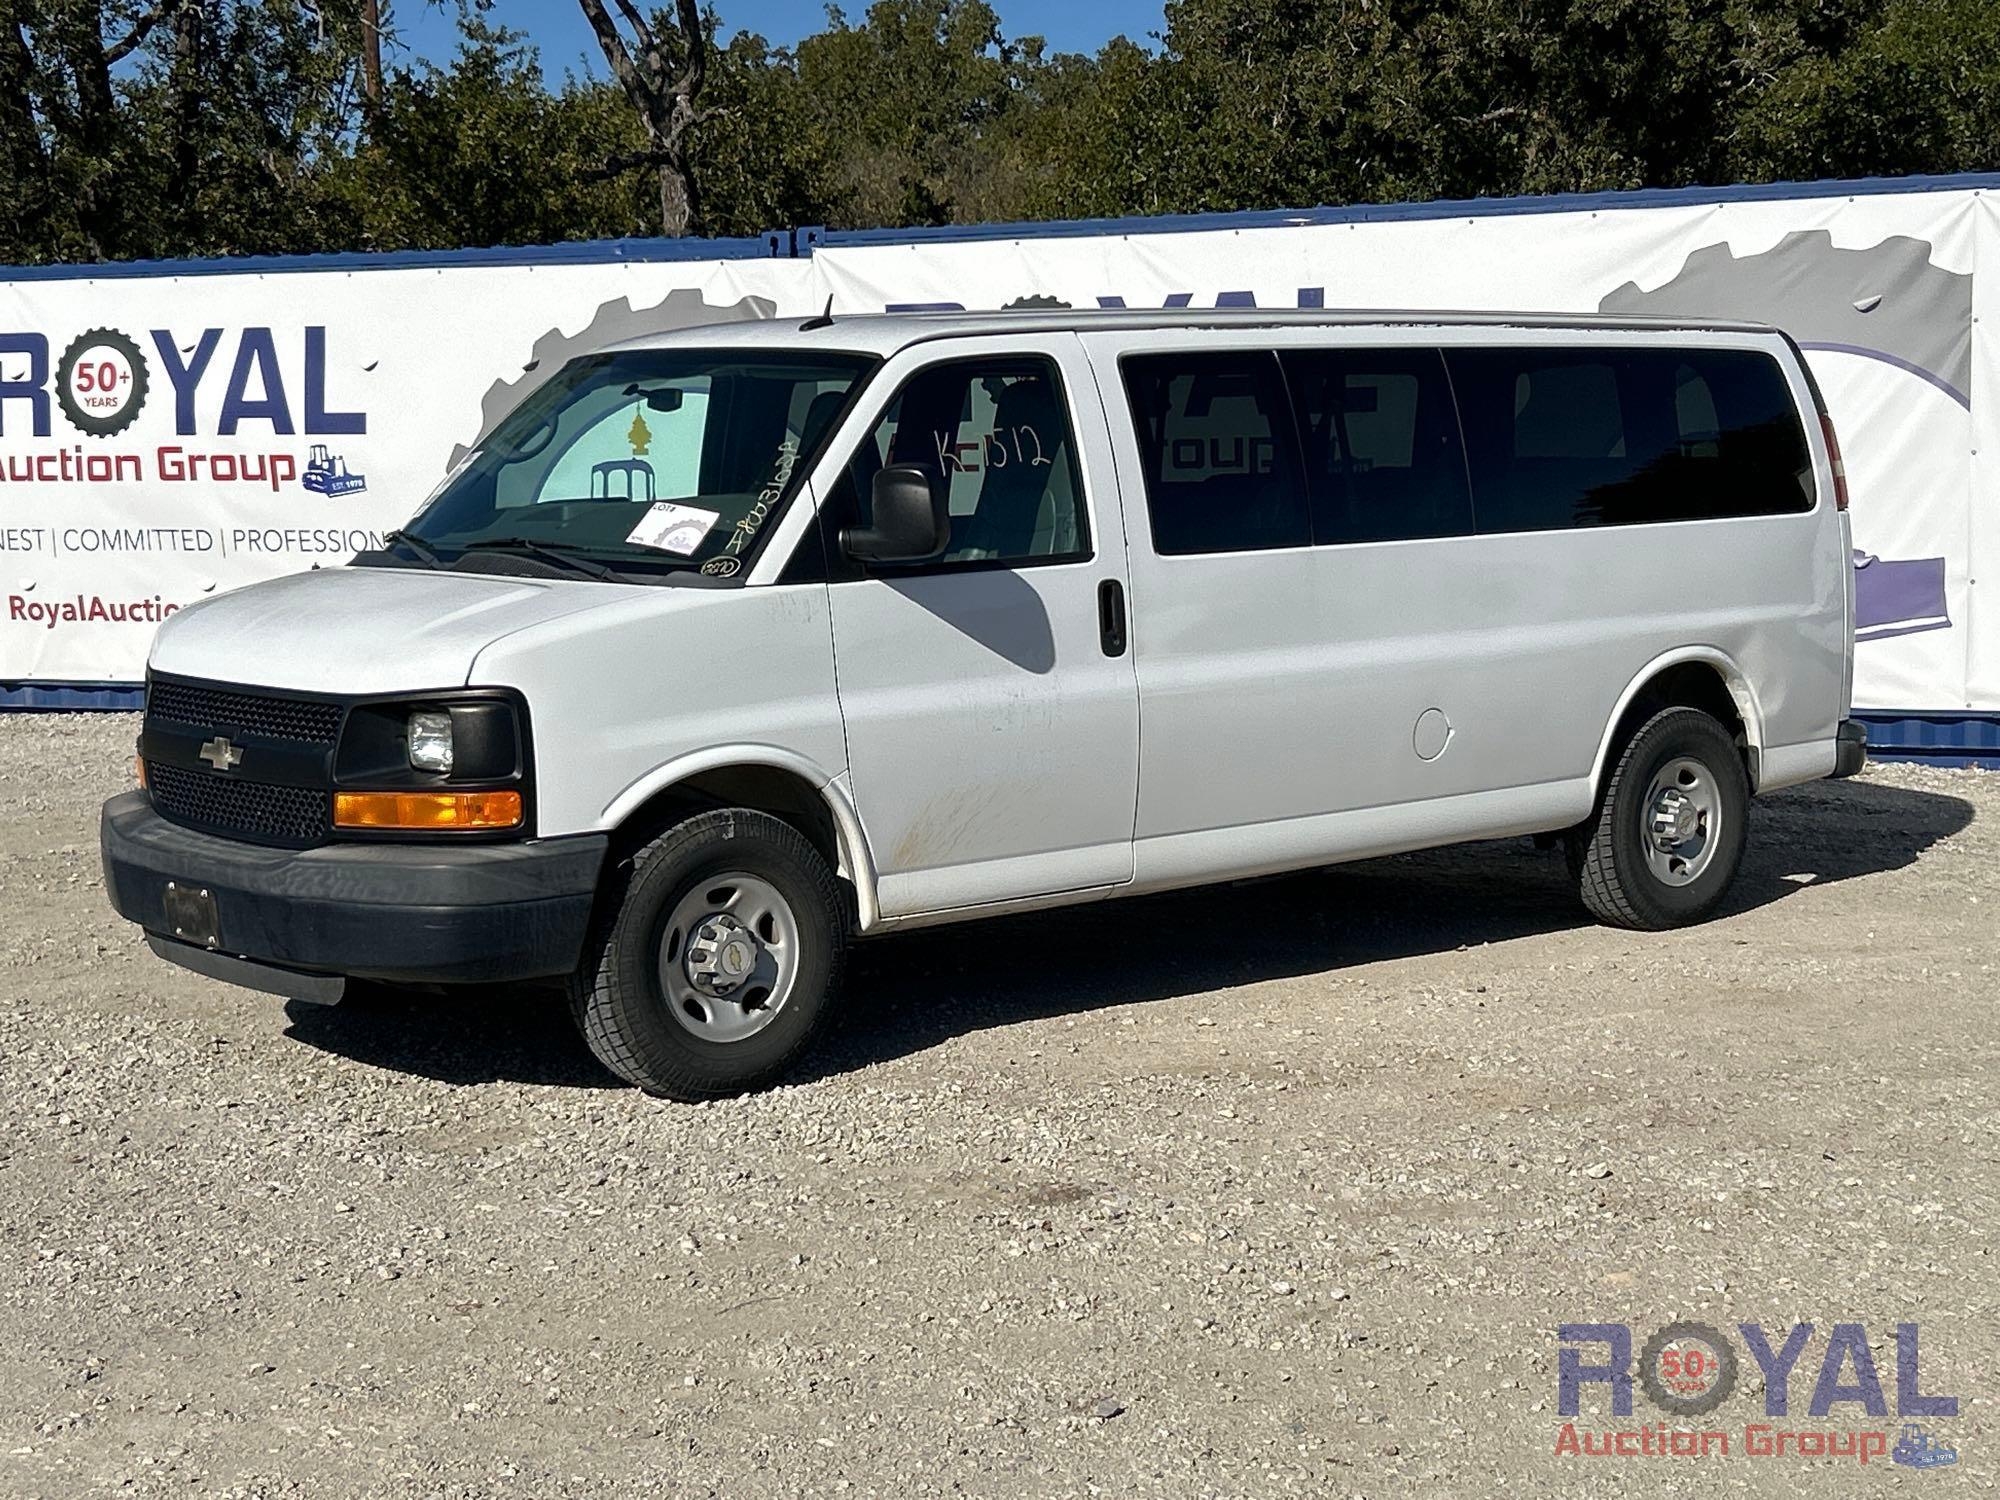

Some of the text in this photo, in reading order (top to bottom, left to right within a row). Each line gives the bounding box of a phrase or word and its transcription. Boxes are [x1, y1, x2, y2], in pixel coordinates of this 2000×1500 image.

[76, 362, 131, 393] 50+
[84, 396, 118, 408] YEARS
[157, 446, 296, 492] Group
[0, 528, 386, 553] EST COMMITTED PROFESSION
[9, 594, 181, 629] RoyalAuctio
